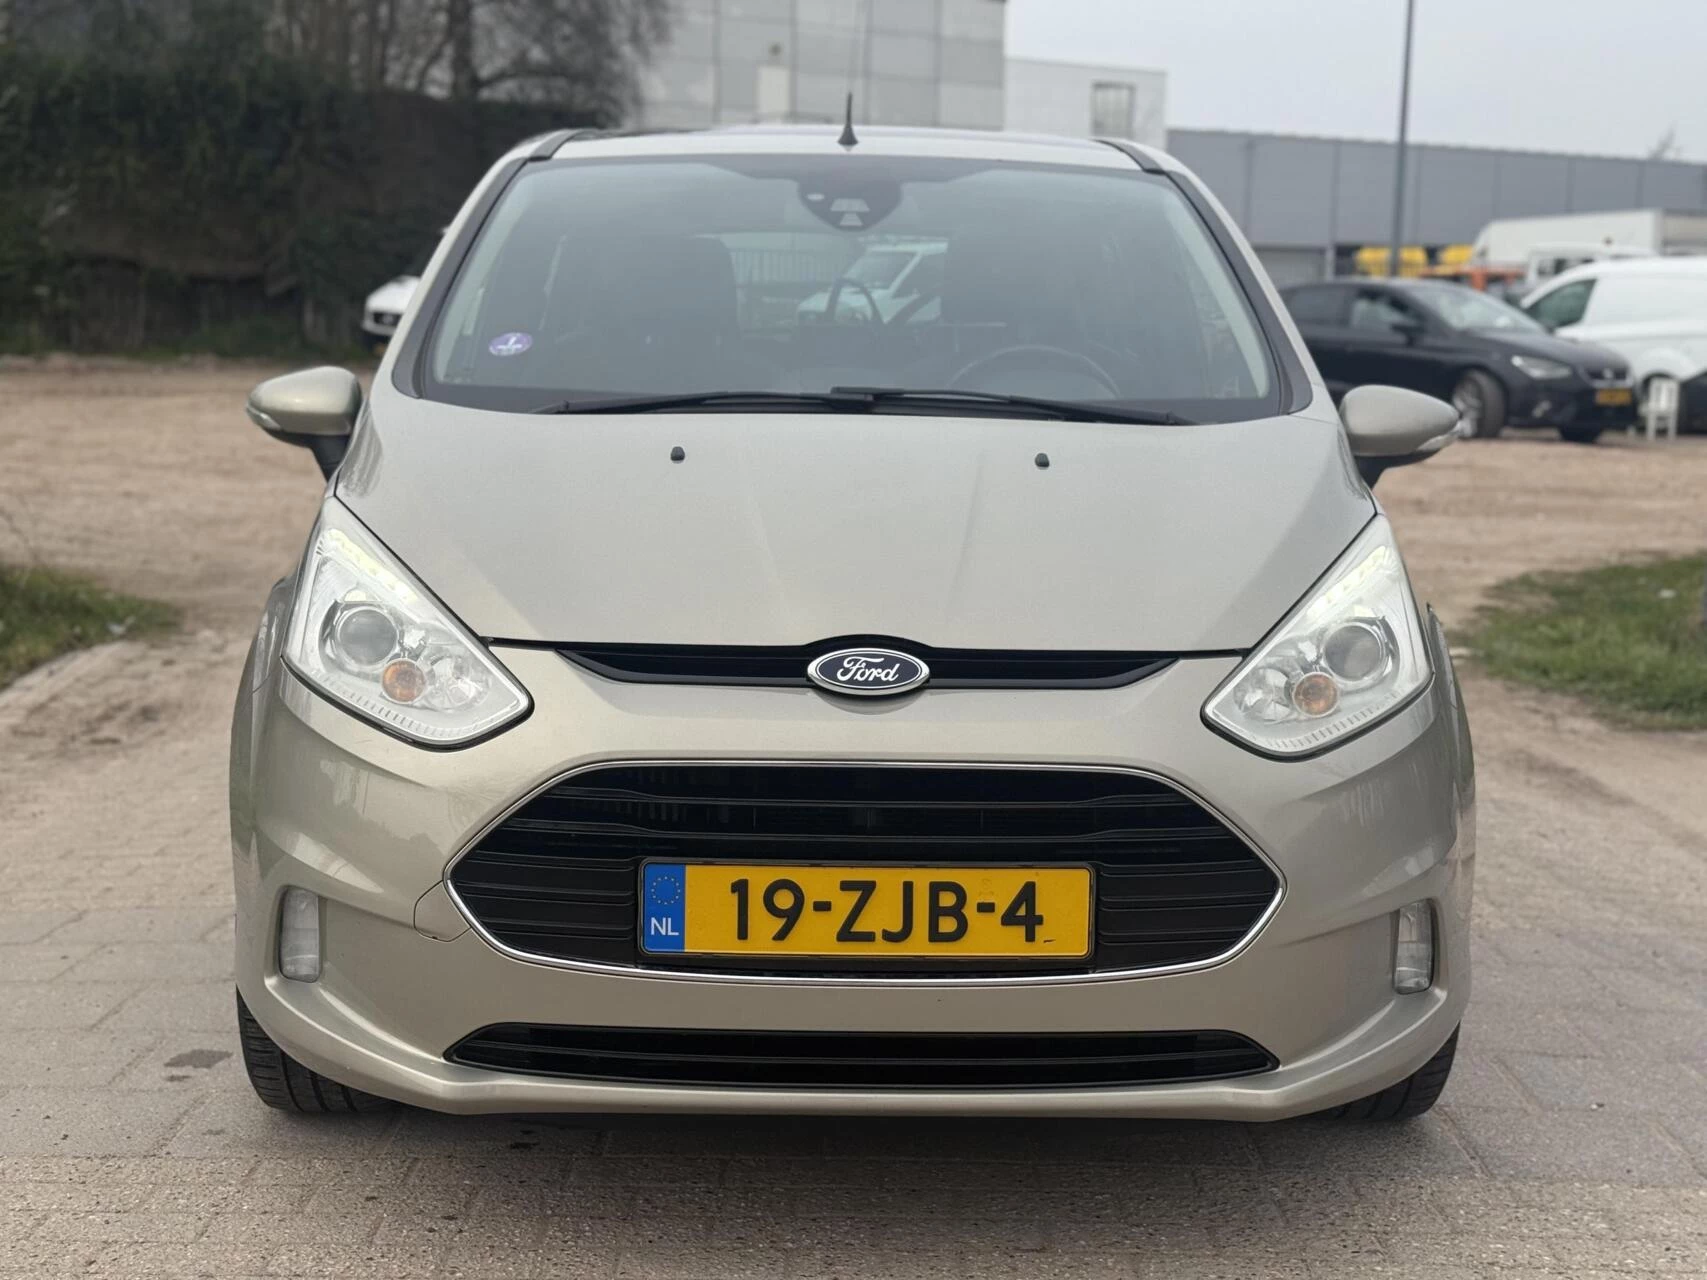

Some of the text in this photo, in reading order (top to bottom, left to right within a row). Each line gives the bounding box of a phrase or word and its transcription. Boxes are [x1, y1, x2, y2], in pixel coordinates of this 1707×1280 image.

[836, 656, 901, 682] Ford
[730, 878, 1044, 943] 19-ZJB-4
[650, 917, 680, 936] NL
